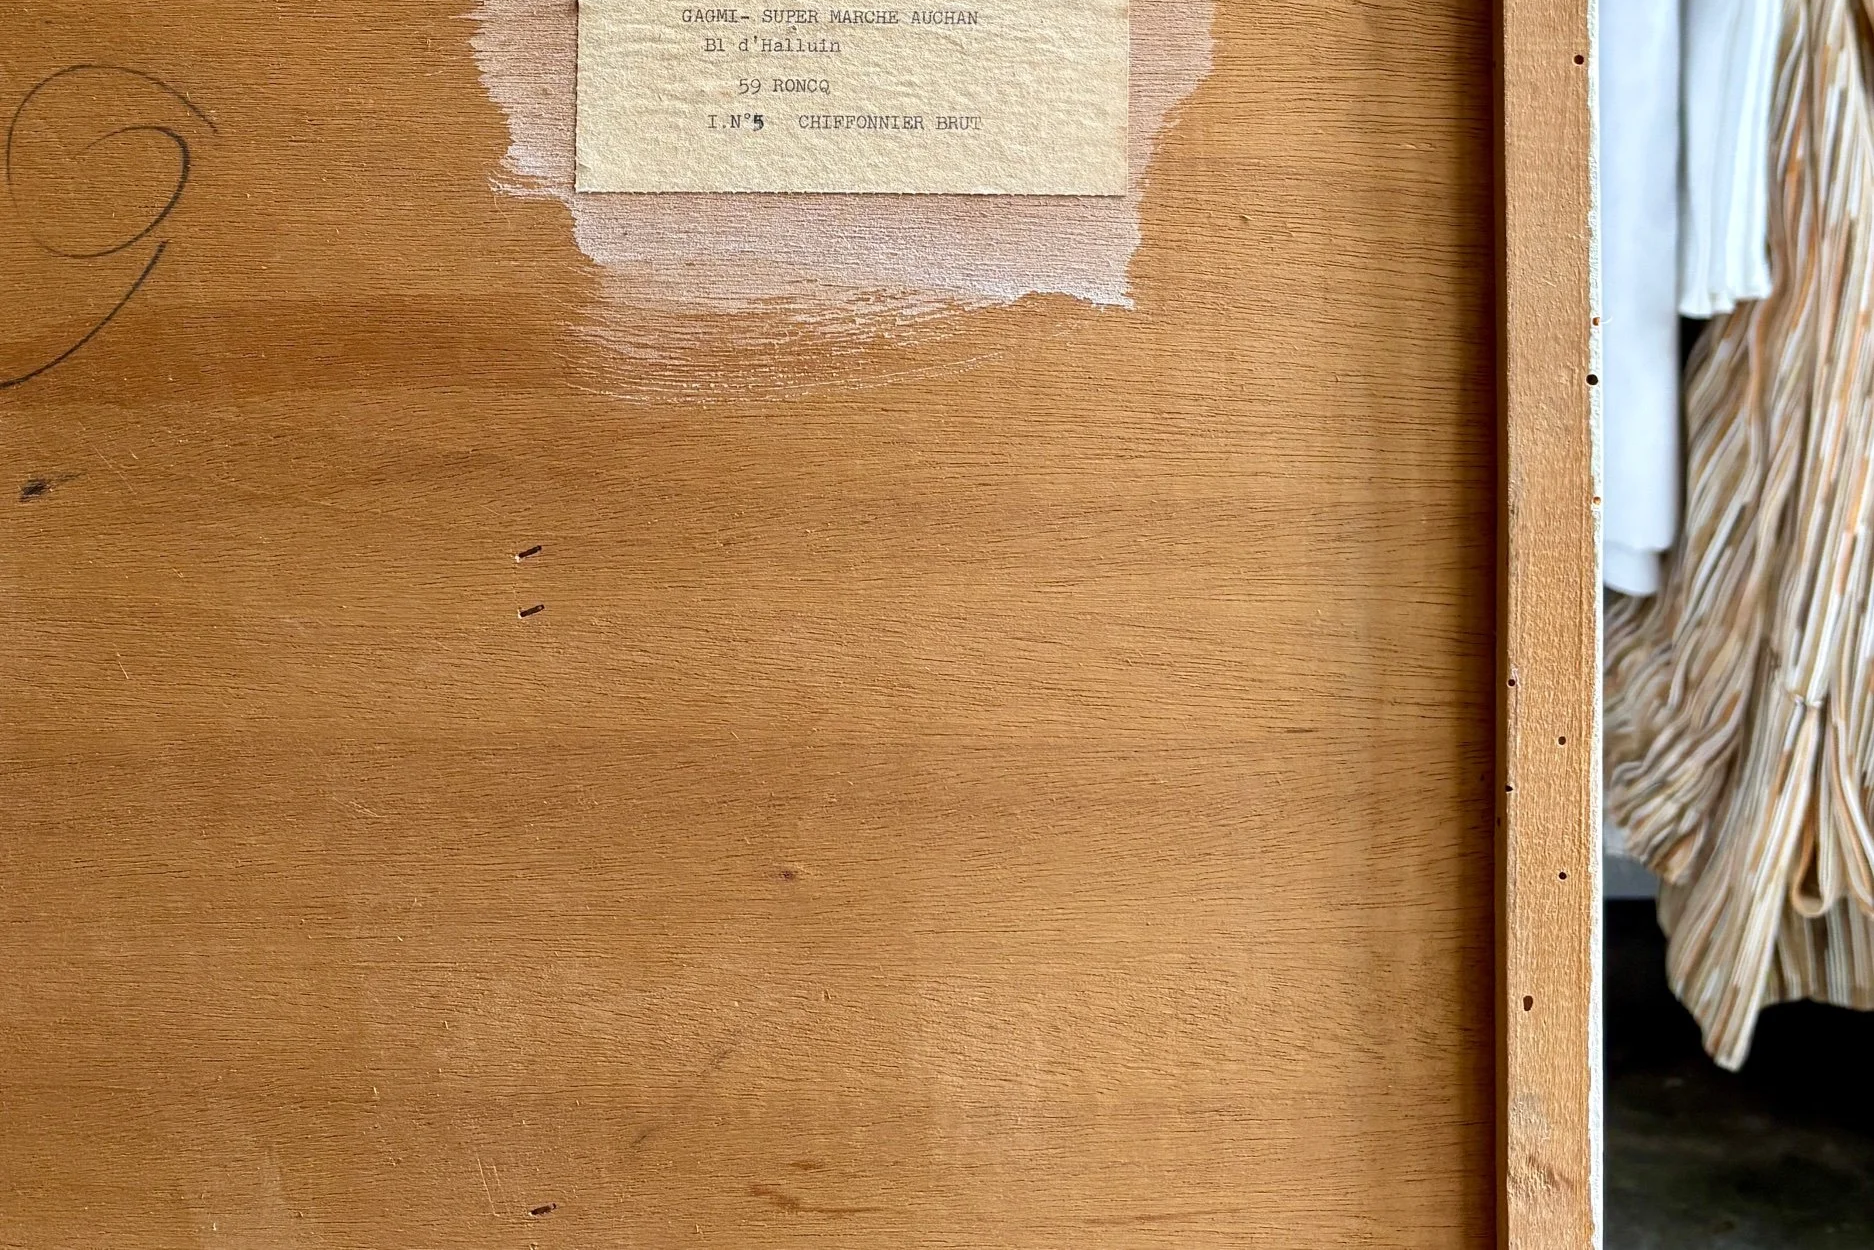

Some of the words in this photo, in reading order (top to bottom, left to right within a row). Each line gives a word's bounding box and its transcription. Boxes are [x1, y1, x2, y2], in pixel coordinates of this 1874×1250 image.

[761, 9, 818, 24] SUPER
[830, 9, 899, 24] MARCHE
[911, 10, 979, 25] AUCHAN
[738, 35, 841, 53] d'Halluin
[738, 78, 762, 95] 59
[772, 78, 831, 95] RONCQ
[798, 114, 925, 130] CHIFFONNIER
[935, 115, 982, 130] BRUT
